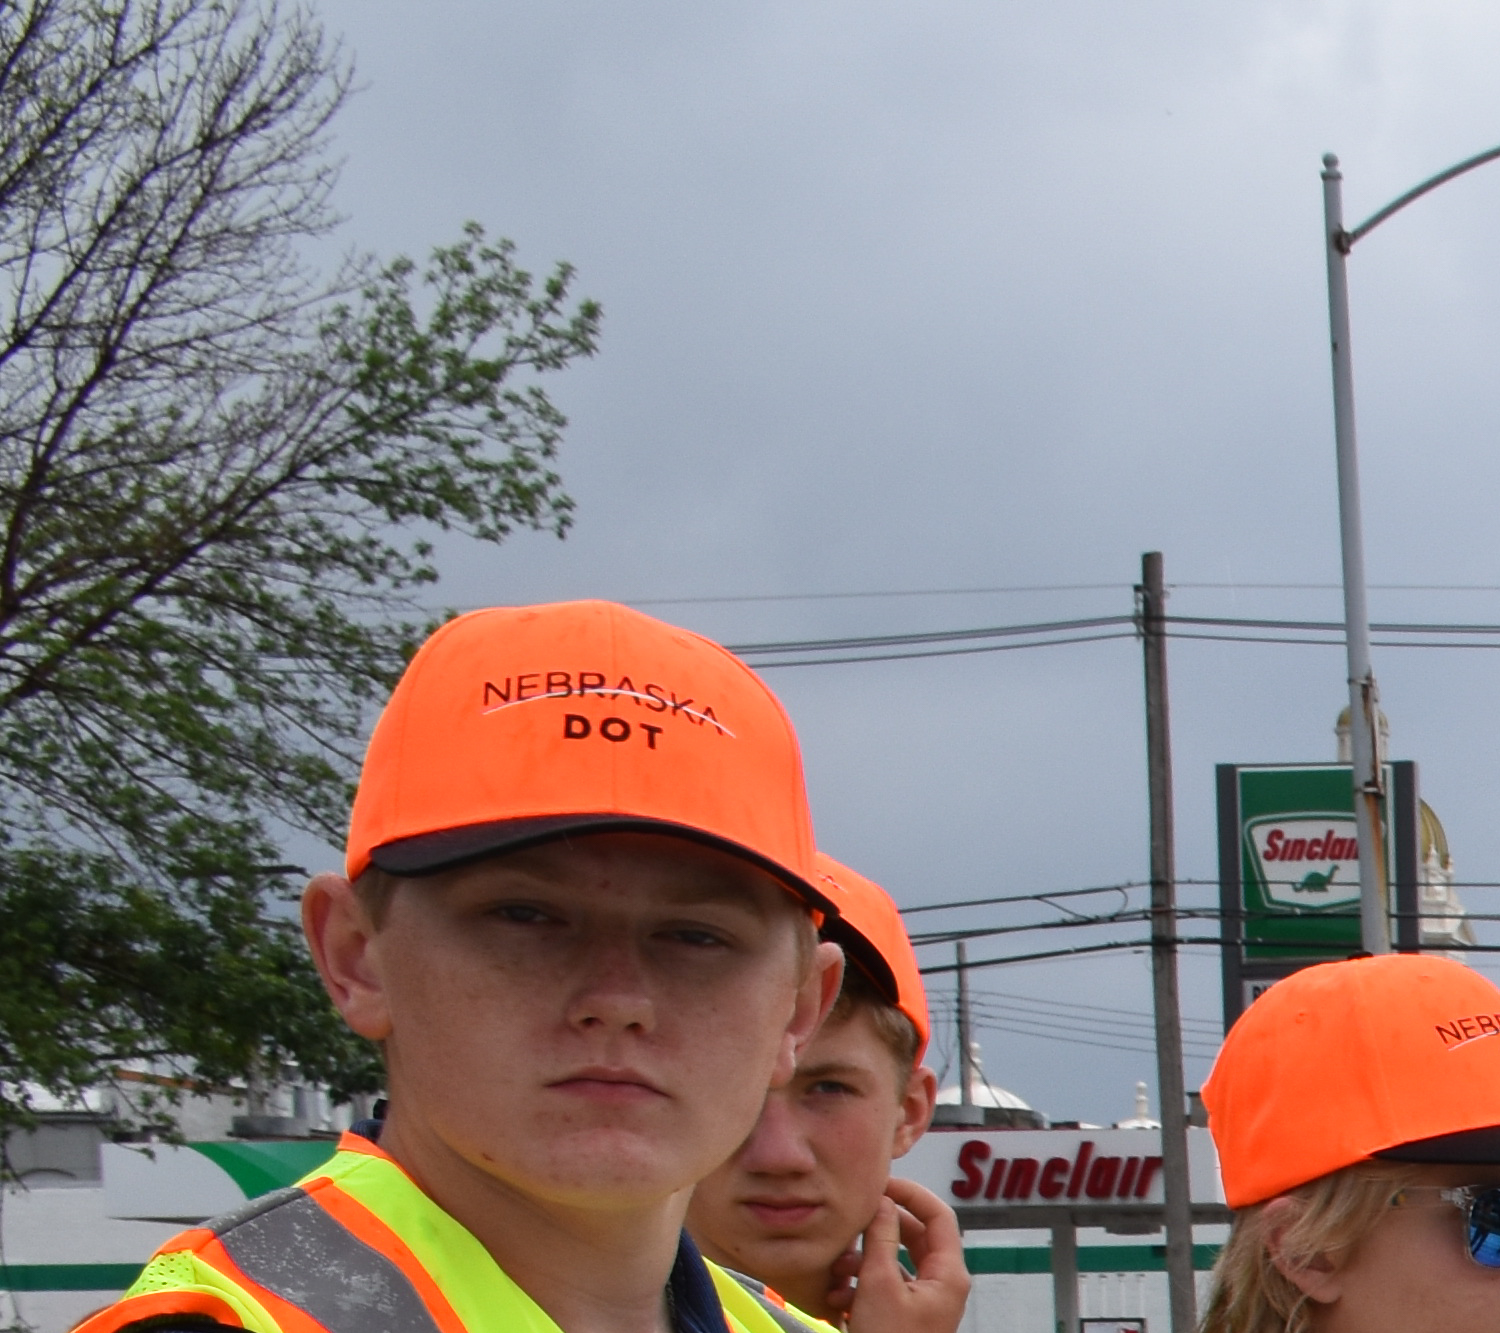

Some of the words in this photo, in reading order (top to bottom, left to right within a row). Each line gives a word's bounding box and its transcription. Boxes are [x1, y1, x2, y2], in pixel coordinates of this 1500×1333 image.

[483, 671, 726, 736] NEBRASKA
[563, 713, 663, 750] DOT
[951, 1139, 1164, 1201] Sinclair
